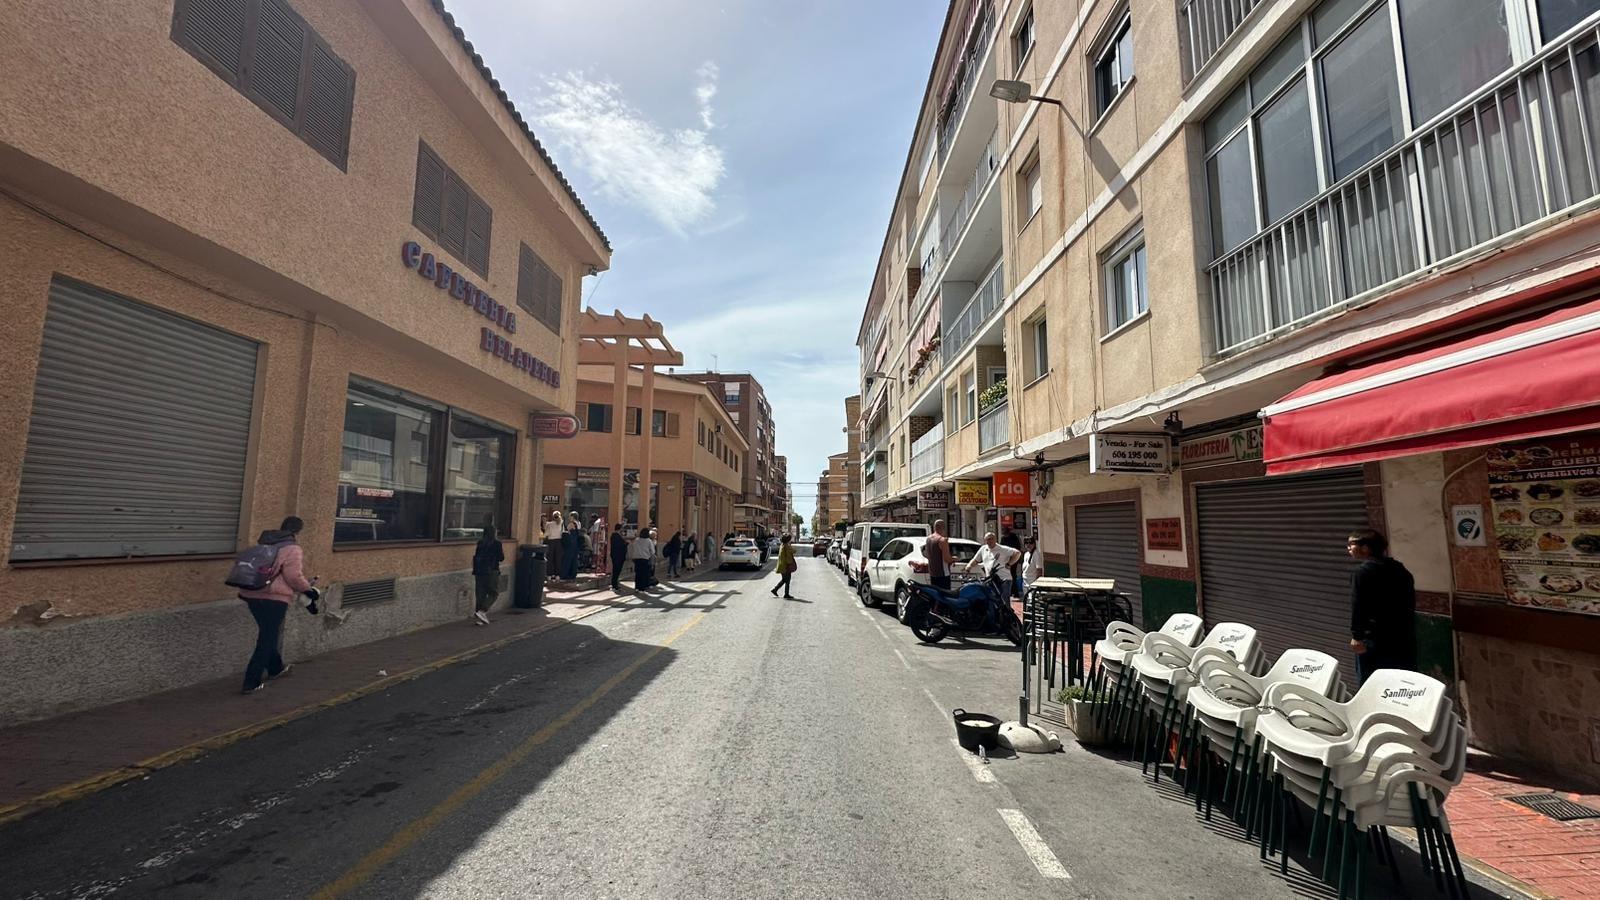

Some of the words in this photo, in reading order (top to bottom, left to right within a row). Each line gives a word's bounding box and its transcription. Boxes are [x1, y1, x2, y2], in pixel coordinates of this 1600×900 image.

[402, 241, 516, 334] CAFETERIA
[480, 327, 560, 388] HELADERIA
[1105, 439, 1127, 447] Vendo
[1133, 440, 1147, 448] For
[1147, 441, 1164, 449] Sale
[1182, 437, 1230, 460] FLORISTERIA
[1112, 450, 1127, 458] 606
[1128, 451, 1142, 459] 195
[1143, 452, 1158, 460] 000
[1551, 455, 1600, 467] GUER
[999, 477, 1024, 495] ria
